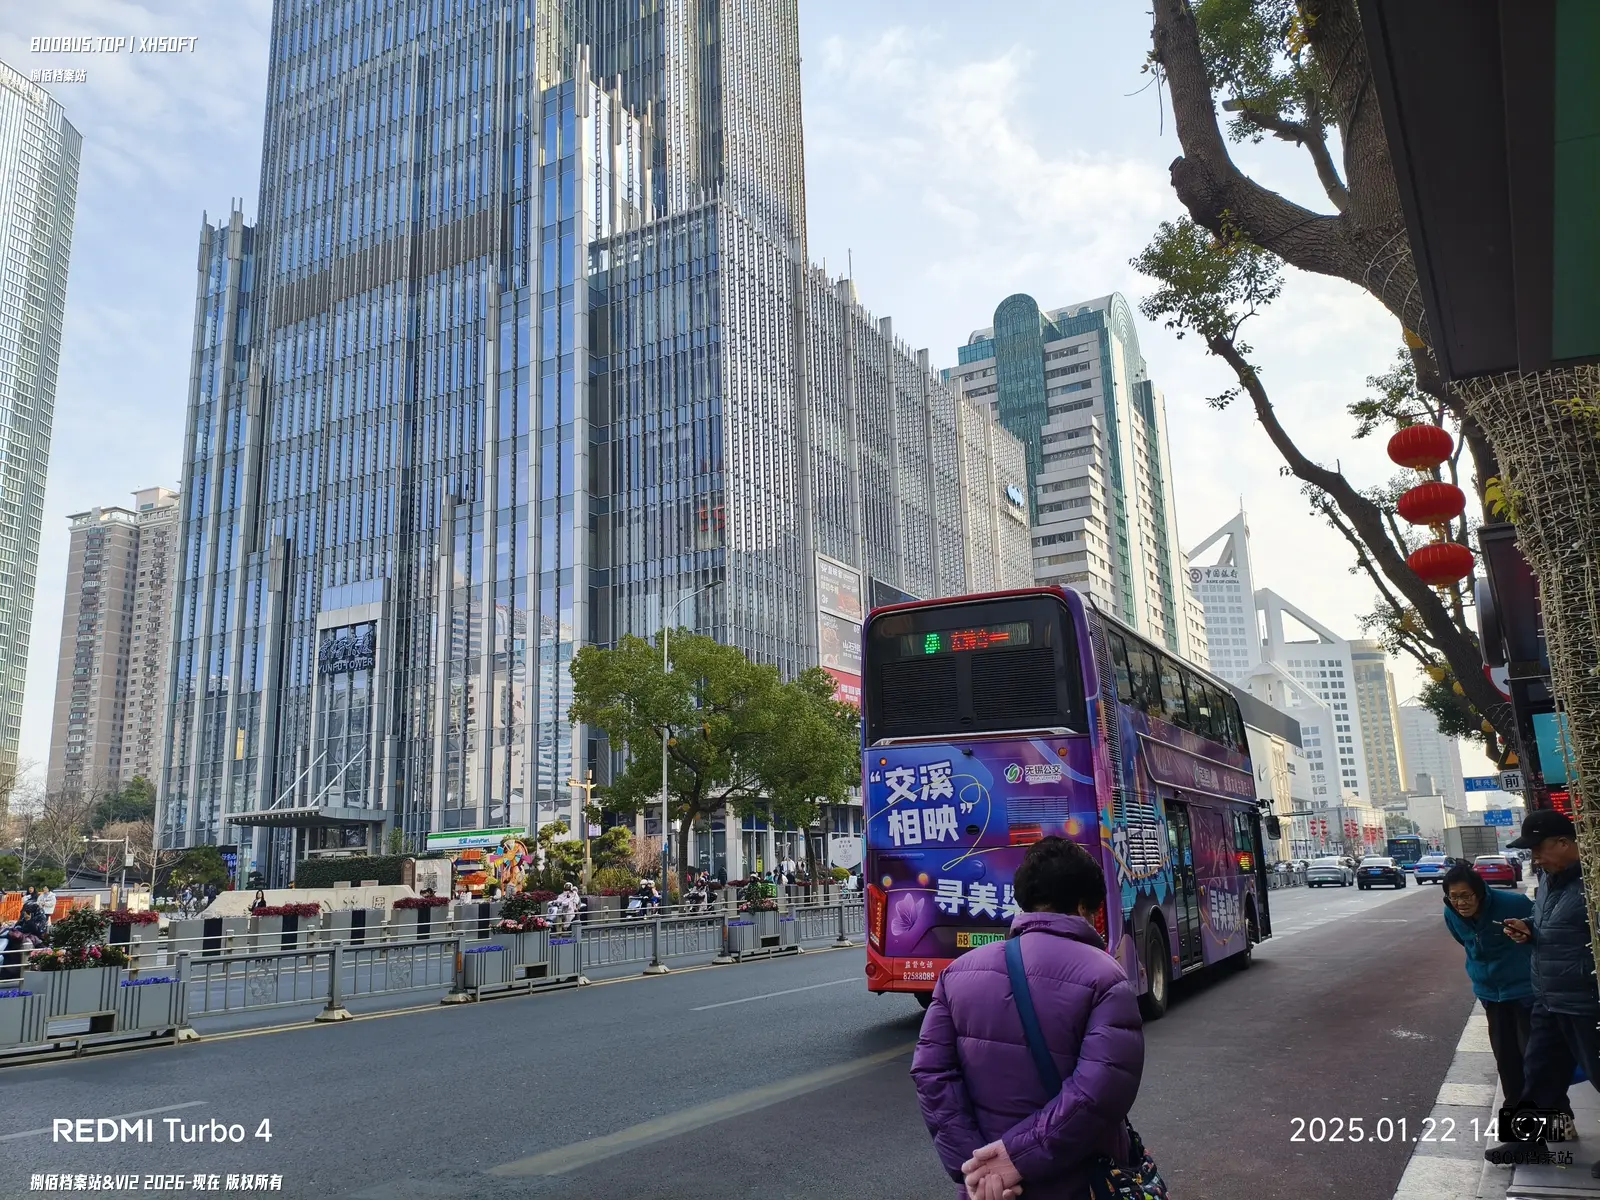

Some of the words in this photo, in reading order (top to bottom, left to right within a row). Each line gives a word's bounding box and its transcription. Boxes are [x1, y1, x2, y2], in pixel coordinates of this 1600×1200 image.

[1205, 569, 1239, 578] 中国银行
[318, 662, 342, 673] YUNFU
[344, 657, 373, 670] TOWER
[1025, 764, 1061, 775] 无锡公交
[1504, 773, 1519, 788] 前
[905, 960, 933, 969] 监督电话
